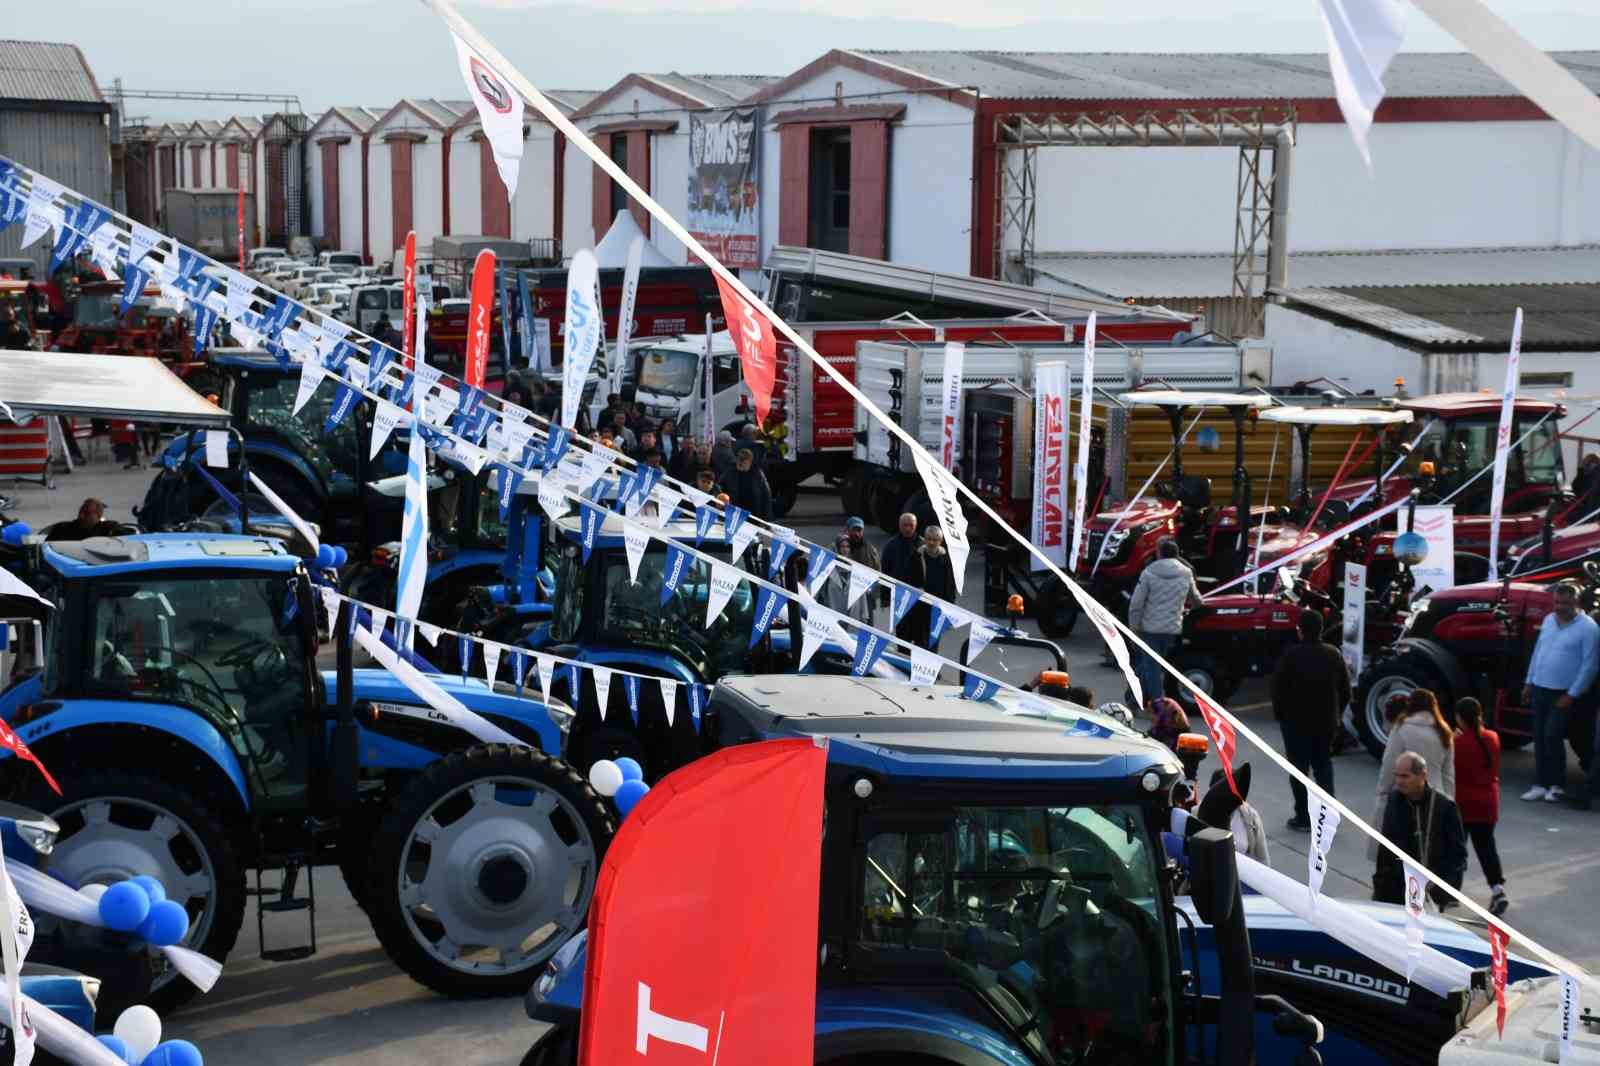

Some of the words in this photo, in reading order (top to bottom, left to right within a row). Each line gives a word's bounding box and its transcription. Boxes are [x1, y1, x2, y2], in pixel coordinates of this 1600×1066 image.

[704, 121, 738, 165] BMS
[626, 535, 646, 549] HAZAR
[712, 577, 735, 591] HAZAR
[808, 617, 832, 635] HAZAR
[912, 662, 936, 677] HAZAR
[1292, 959, 1411, 999] LANDINI
[1562, 979, 1573, 1041] ERKUNT
